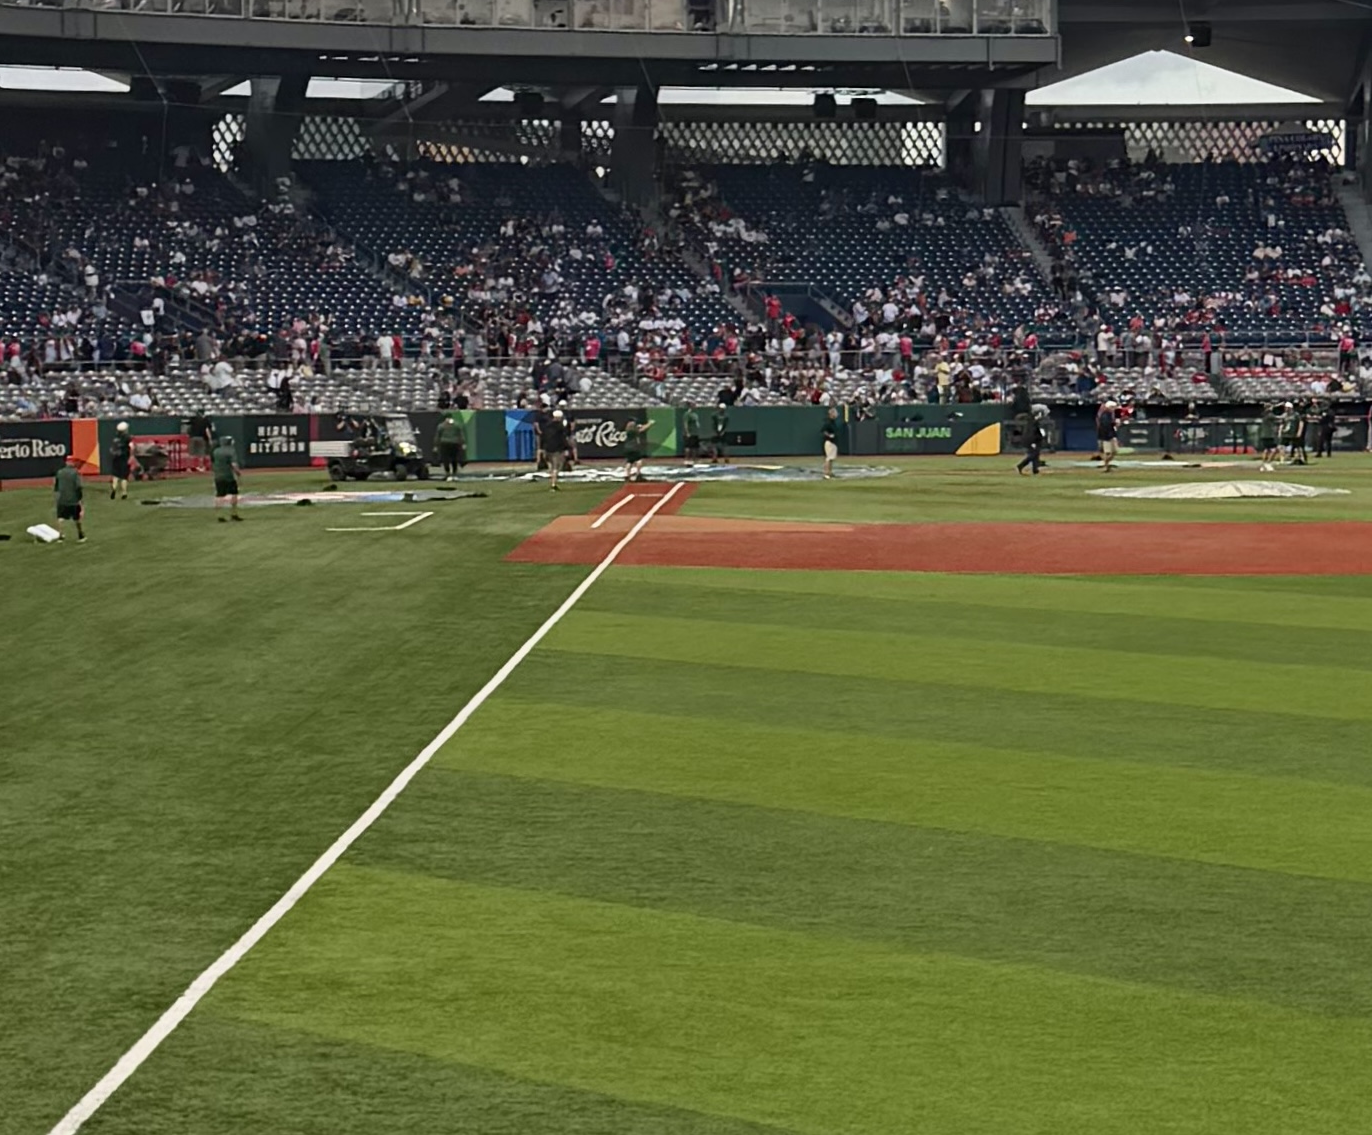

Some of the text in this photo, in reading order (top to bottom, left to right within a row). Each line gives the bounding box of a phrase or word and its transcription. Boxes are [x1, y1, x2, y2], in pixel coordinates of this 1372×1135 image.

[257, 426, 297, 437] HIRAM
[595, 421, 628, 447] Rico
[885, 427, 952, 438] SAN JUAN
[32, 439, 66, 458] Rico
[250, 442, 305, 453] BITHORN
